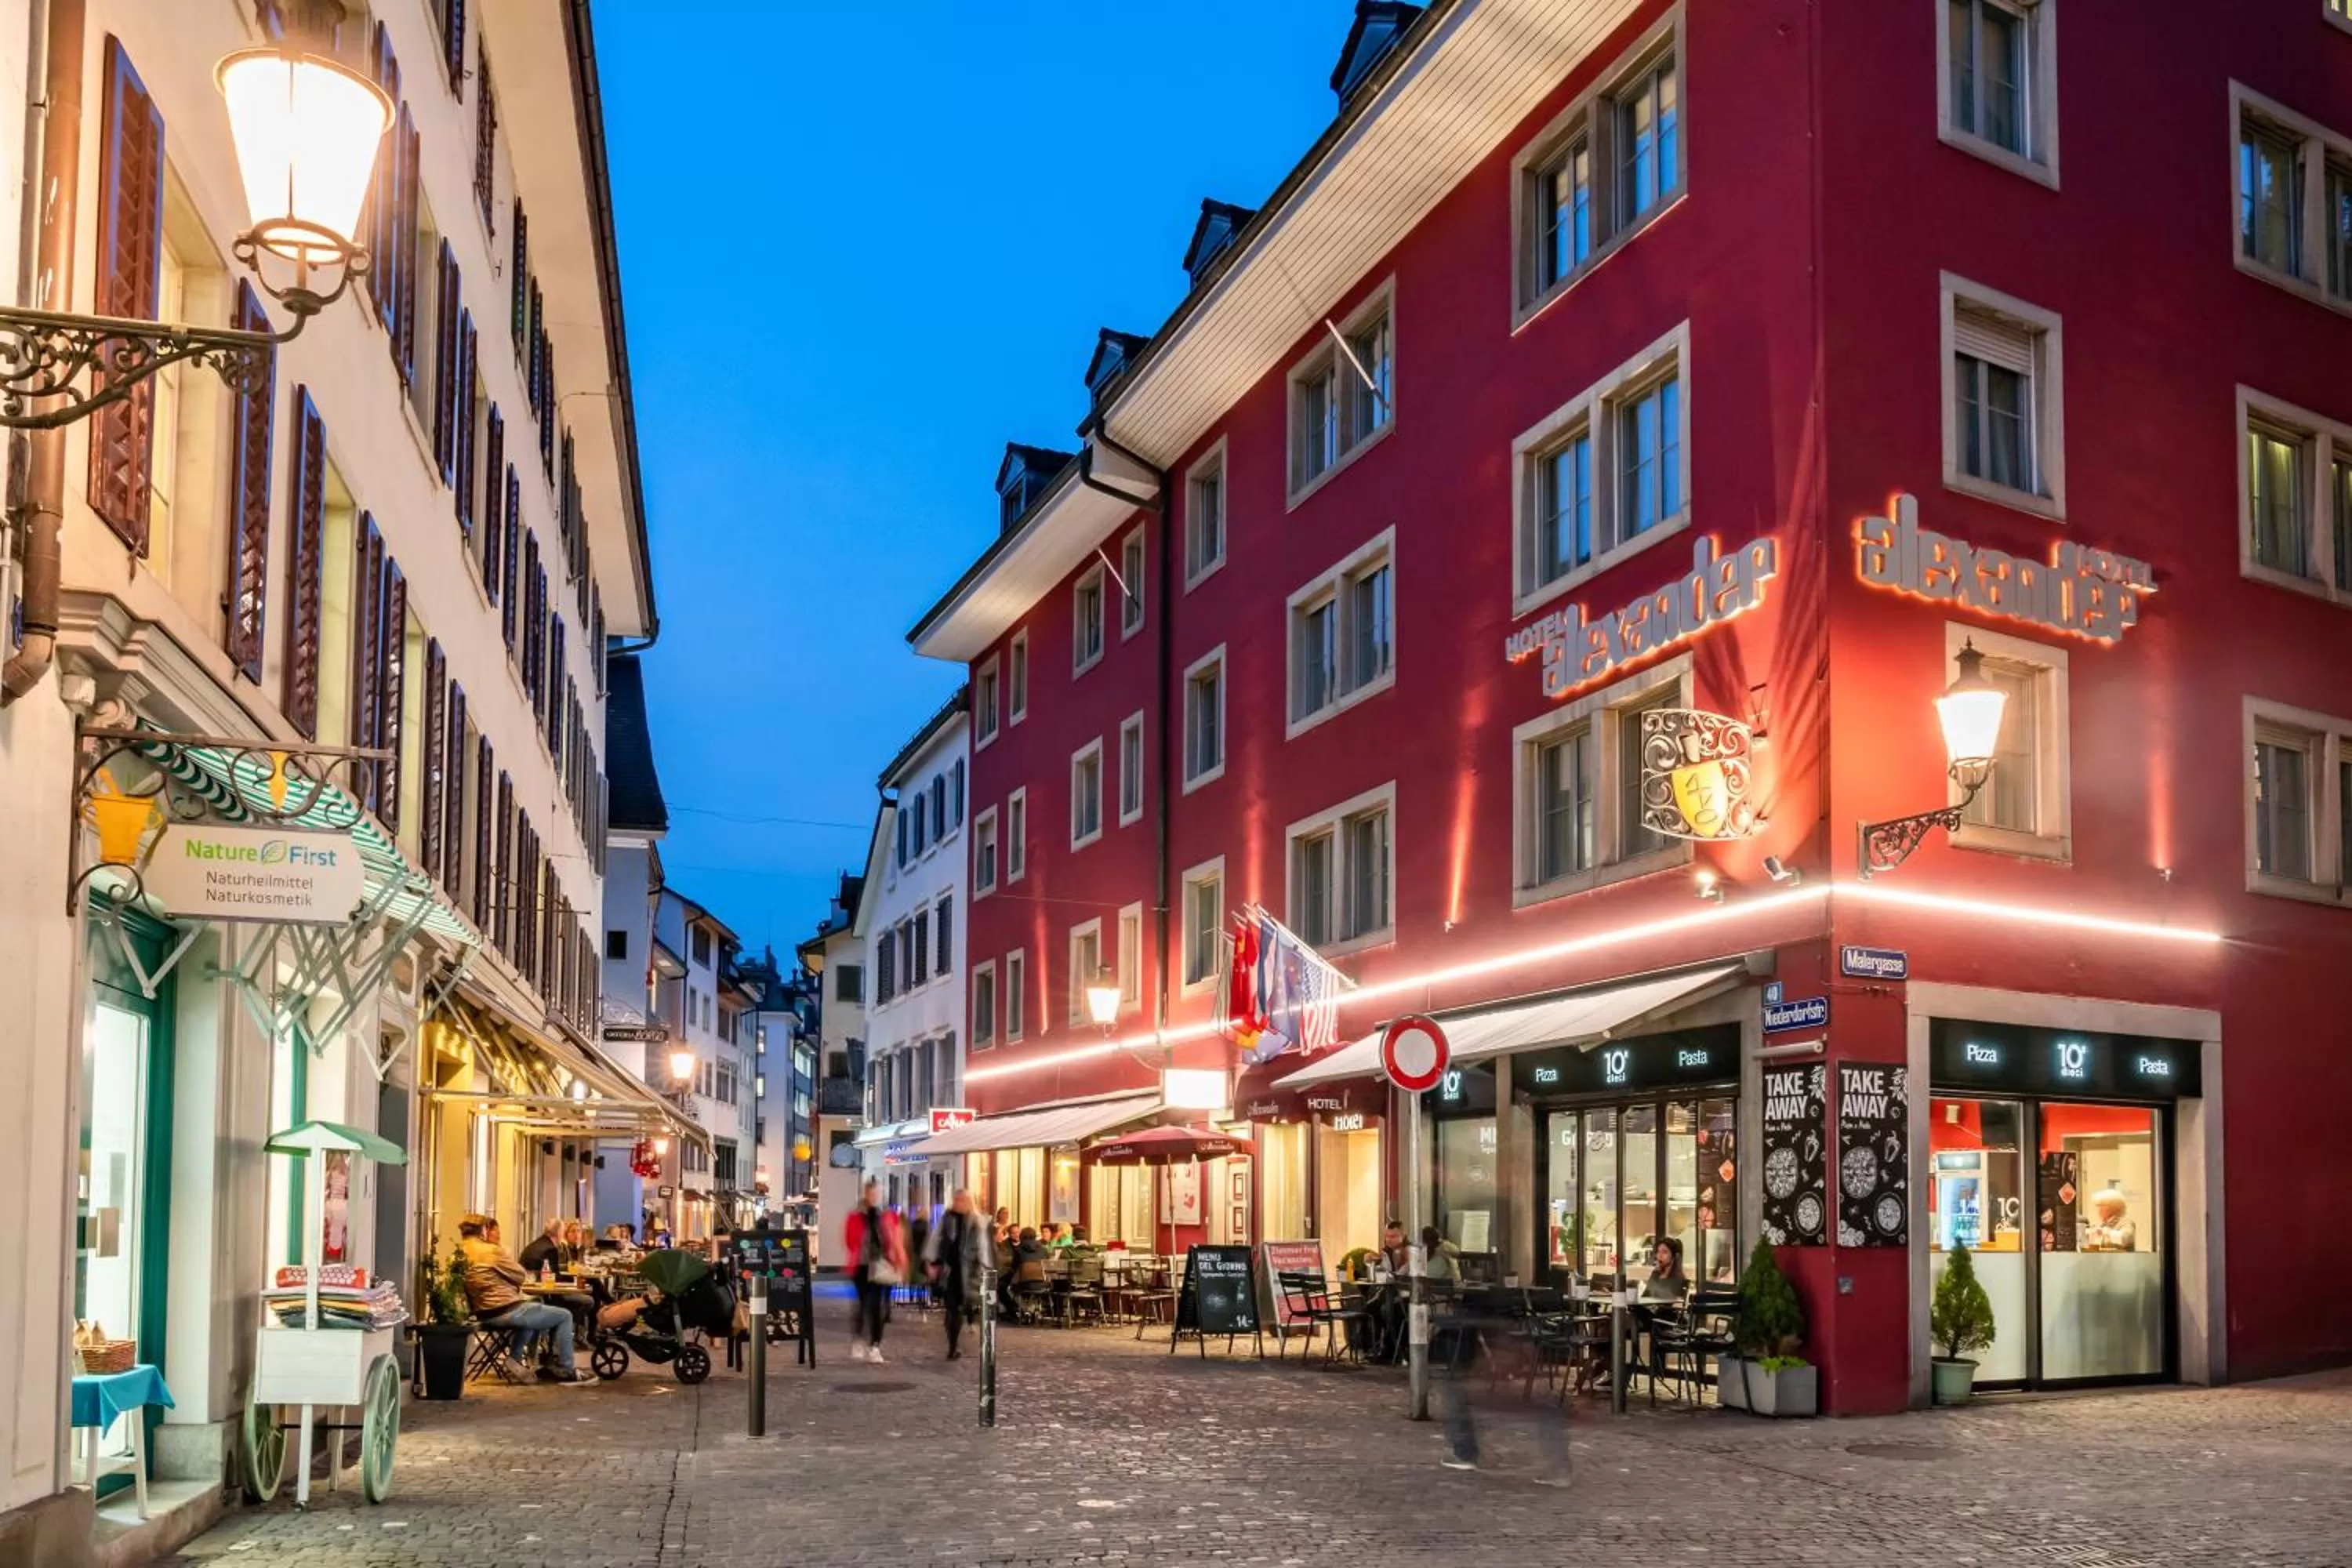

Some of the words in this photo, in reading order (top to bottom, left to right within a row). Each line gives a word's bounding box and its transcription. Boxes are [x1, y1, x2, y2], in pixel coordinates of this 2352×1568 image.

[1504, 610, 1566, 662] HOTEL
[186, 840, 257, 862] Nature
[289, 847, 336, 866] First
[205, 871, 314, 890] Naturheilmittel
[205, 888, 312, 906] Naturkosmetik
[1846, 949, 1904, 975] Malergasse
[1767, 986, 1777, 1001] 40
[1679, 1051, 1708, 1066] Pasta
[1966, 1044, 1998, 1063] Pizza
[1536, 1069, 1558, 1082] Pizza
[2140, 1058, 2169, 1076] Pasta
[1765, 1072, 1804, 1096] TAKE
[1841, 1069, 1884, 1094] TAKE
[1307, 1098, 1342, 1110] HOTEL
[1765, 1096, 1809, 1120] AWAY
[1841, 1094, 1888, 1119] AWAY
